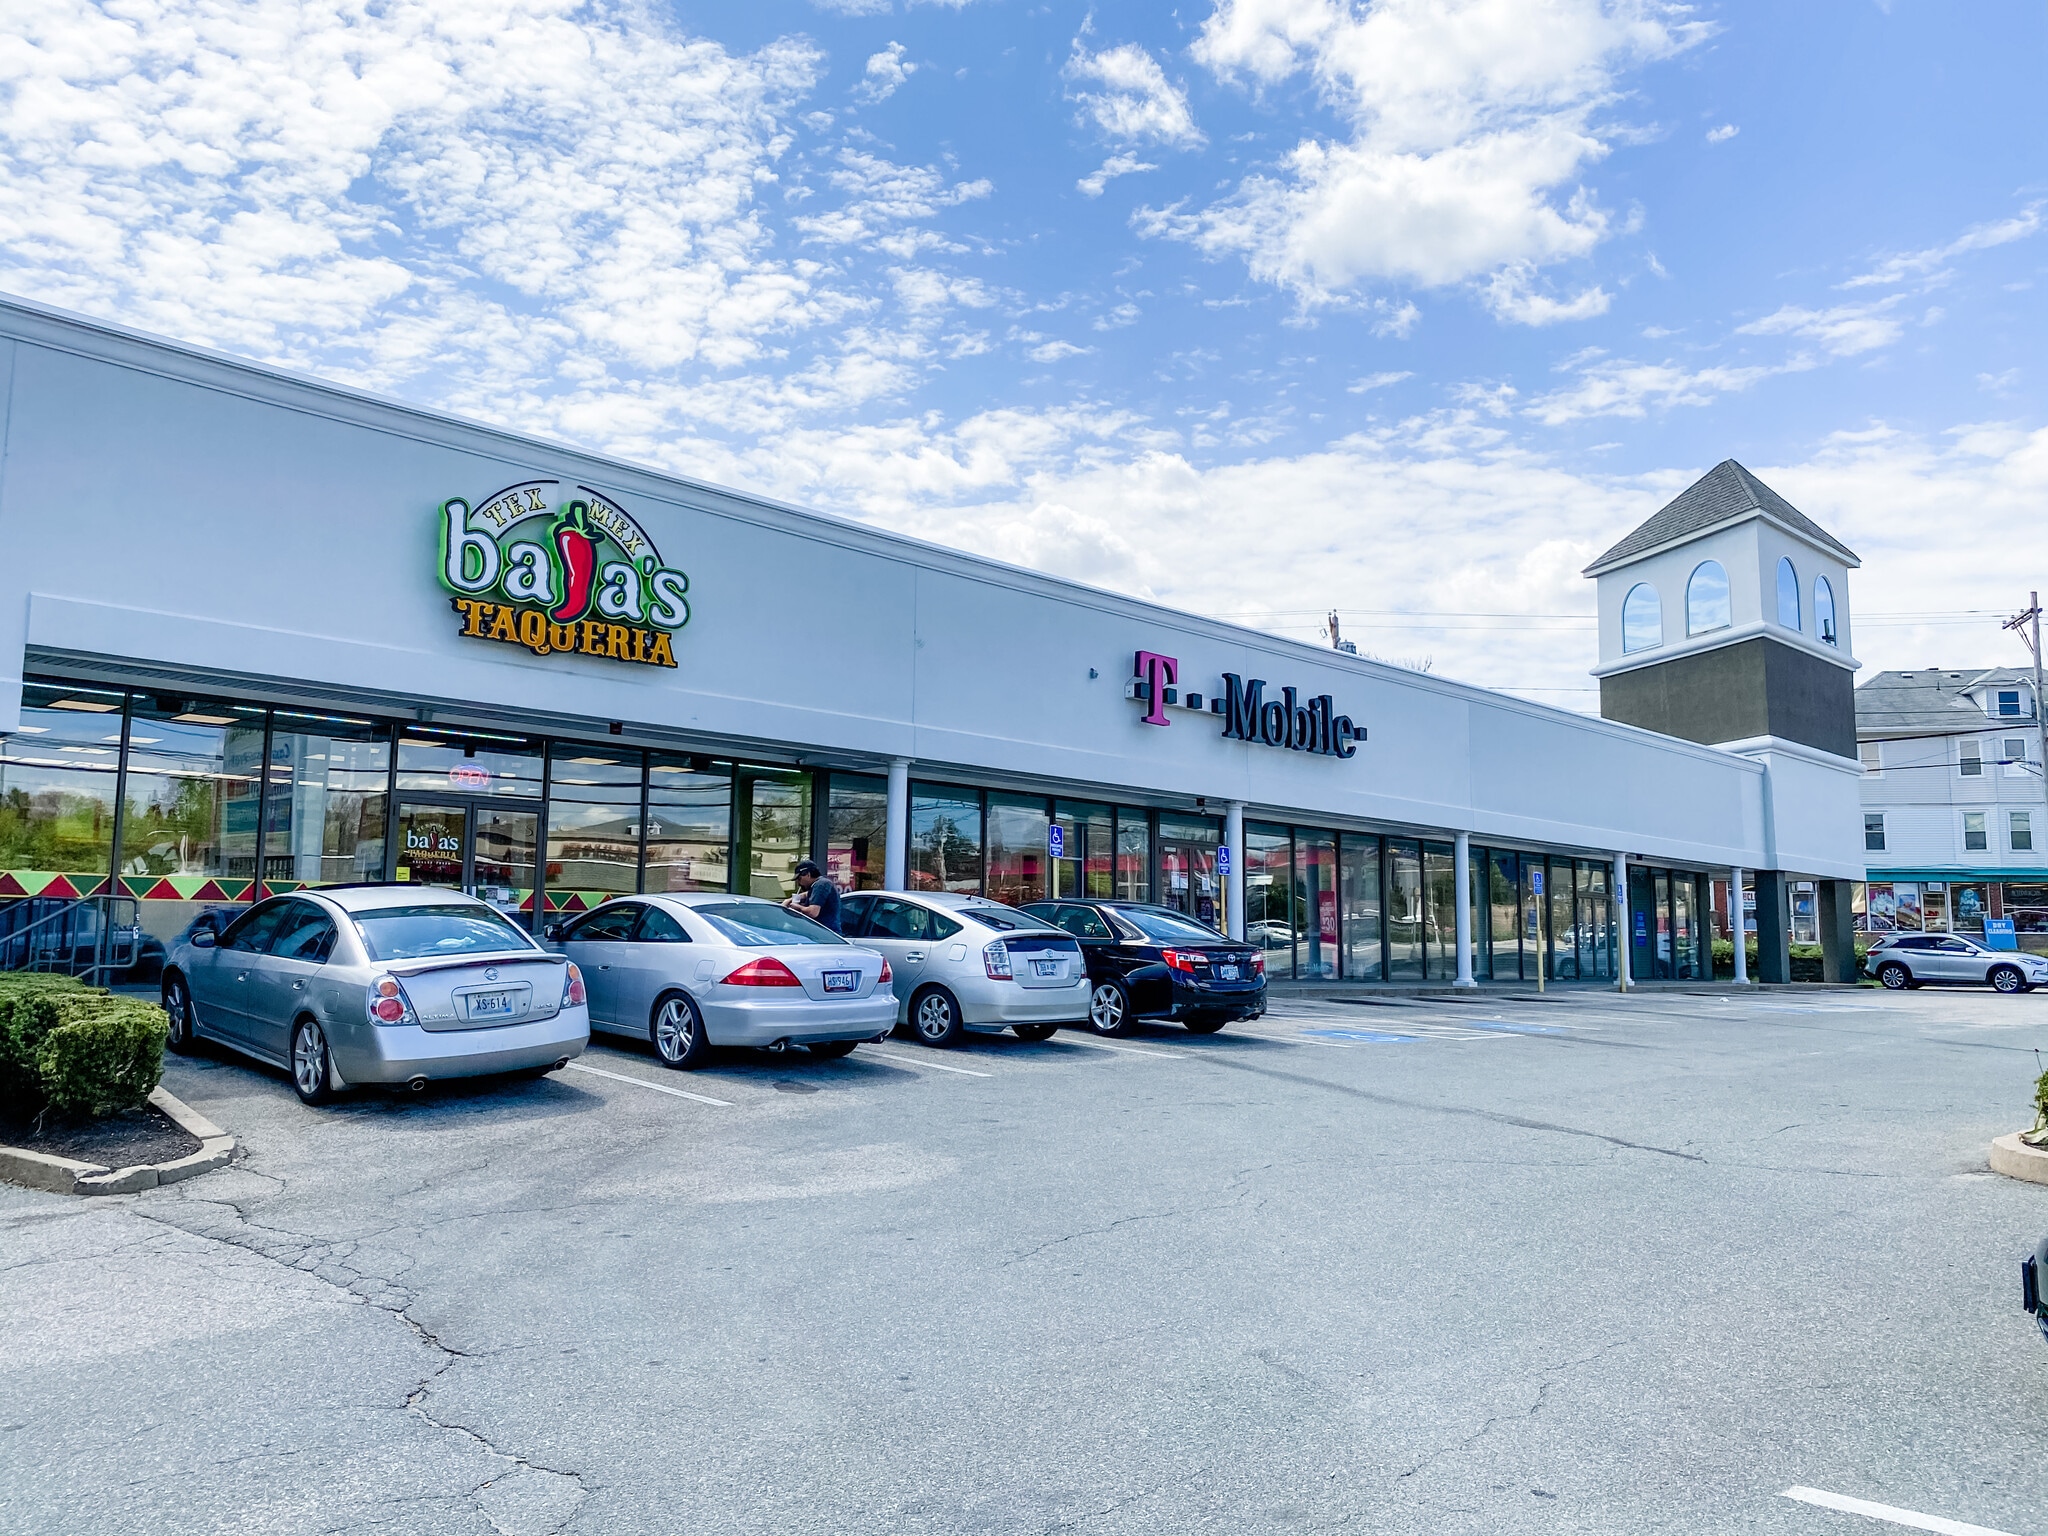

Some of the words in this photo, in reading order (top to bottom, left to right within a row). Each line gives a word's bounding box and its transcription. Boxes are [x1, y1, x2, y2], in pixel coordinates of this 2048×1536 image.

[483, 488, 546, 527] TEX
[589, 498, 645, 556] MEX
[450, 598, 678, 668] TAQUERIA
[450, 768, 489, 785] OPEN
